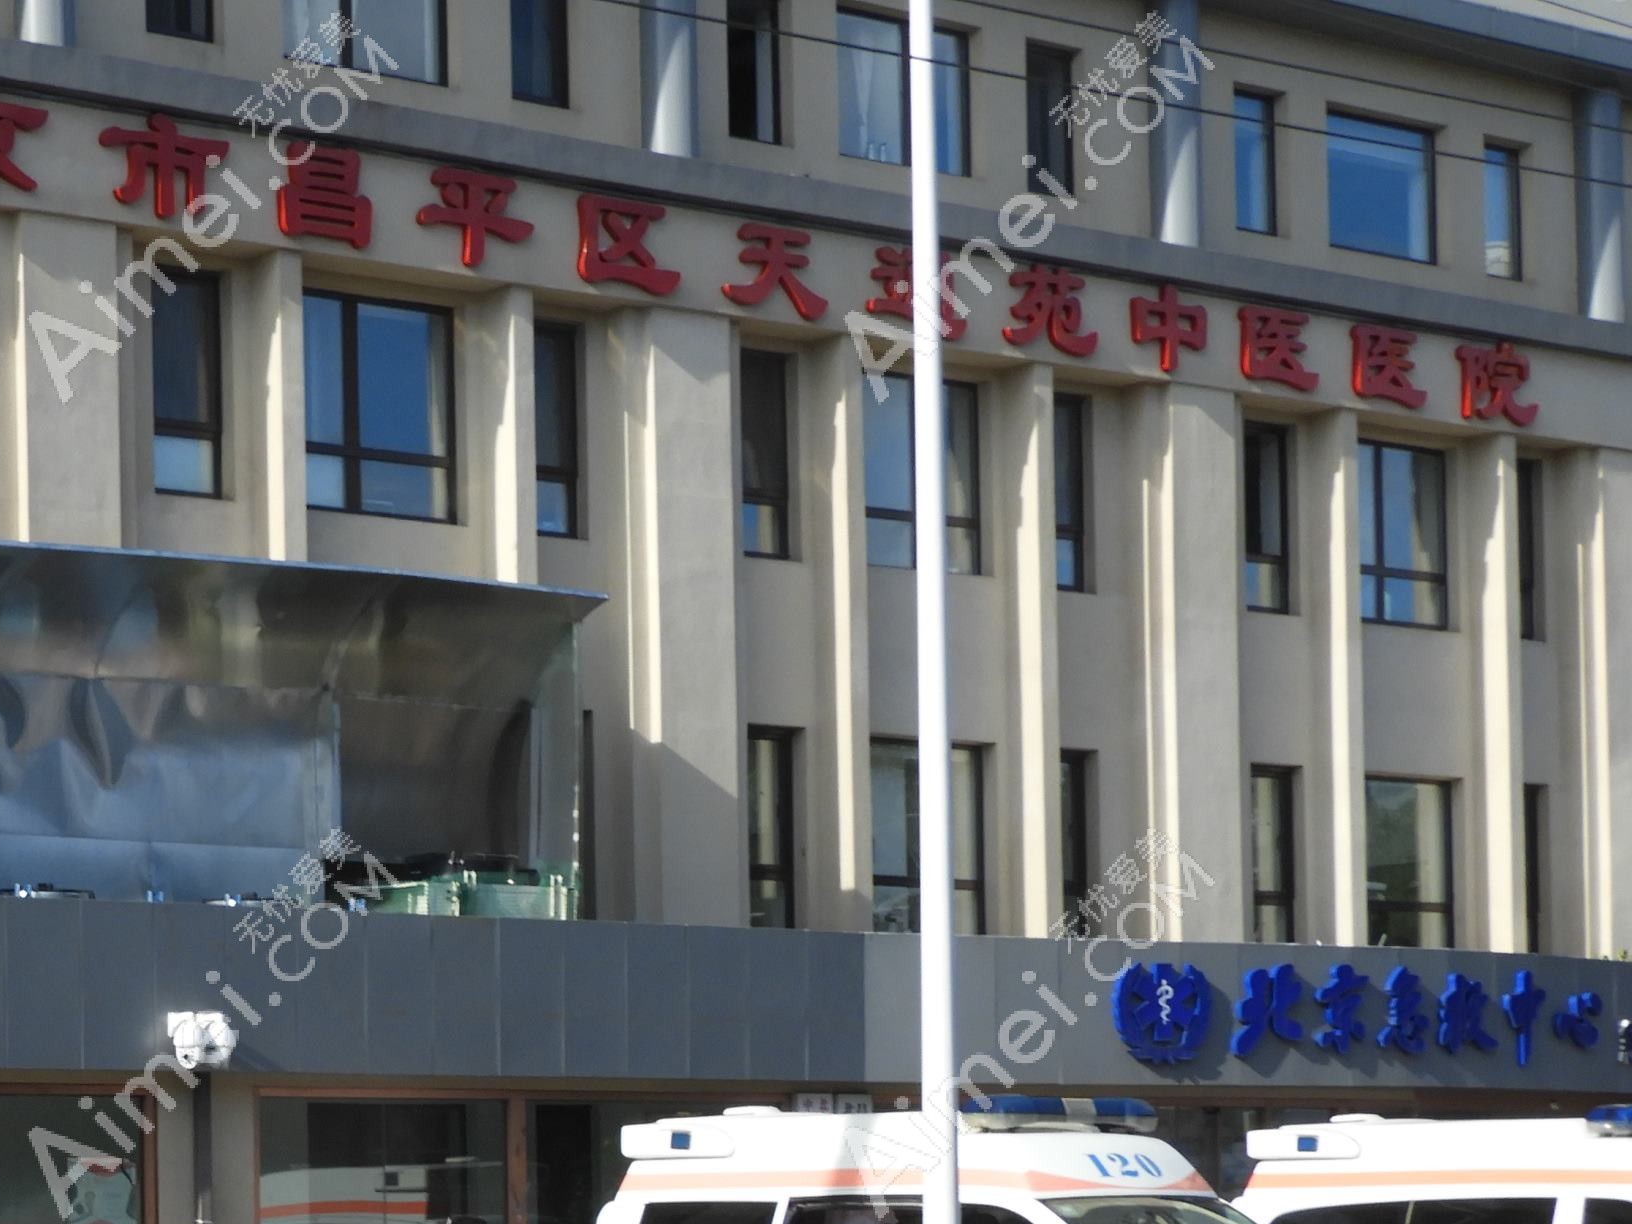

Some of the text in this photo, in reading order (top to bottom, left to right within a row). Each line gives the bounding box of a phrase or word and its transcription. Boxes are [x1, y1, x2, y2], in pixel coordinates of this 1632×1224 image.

[1230, 962, 1603, 1068] 北京急救中心
[1084, 1152, 1163, 1178] 120
